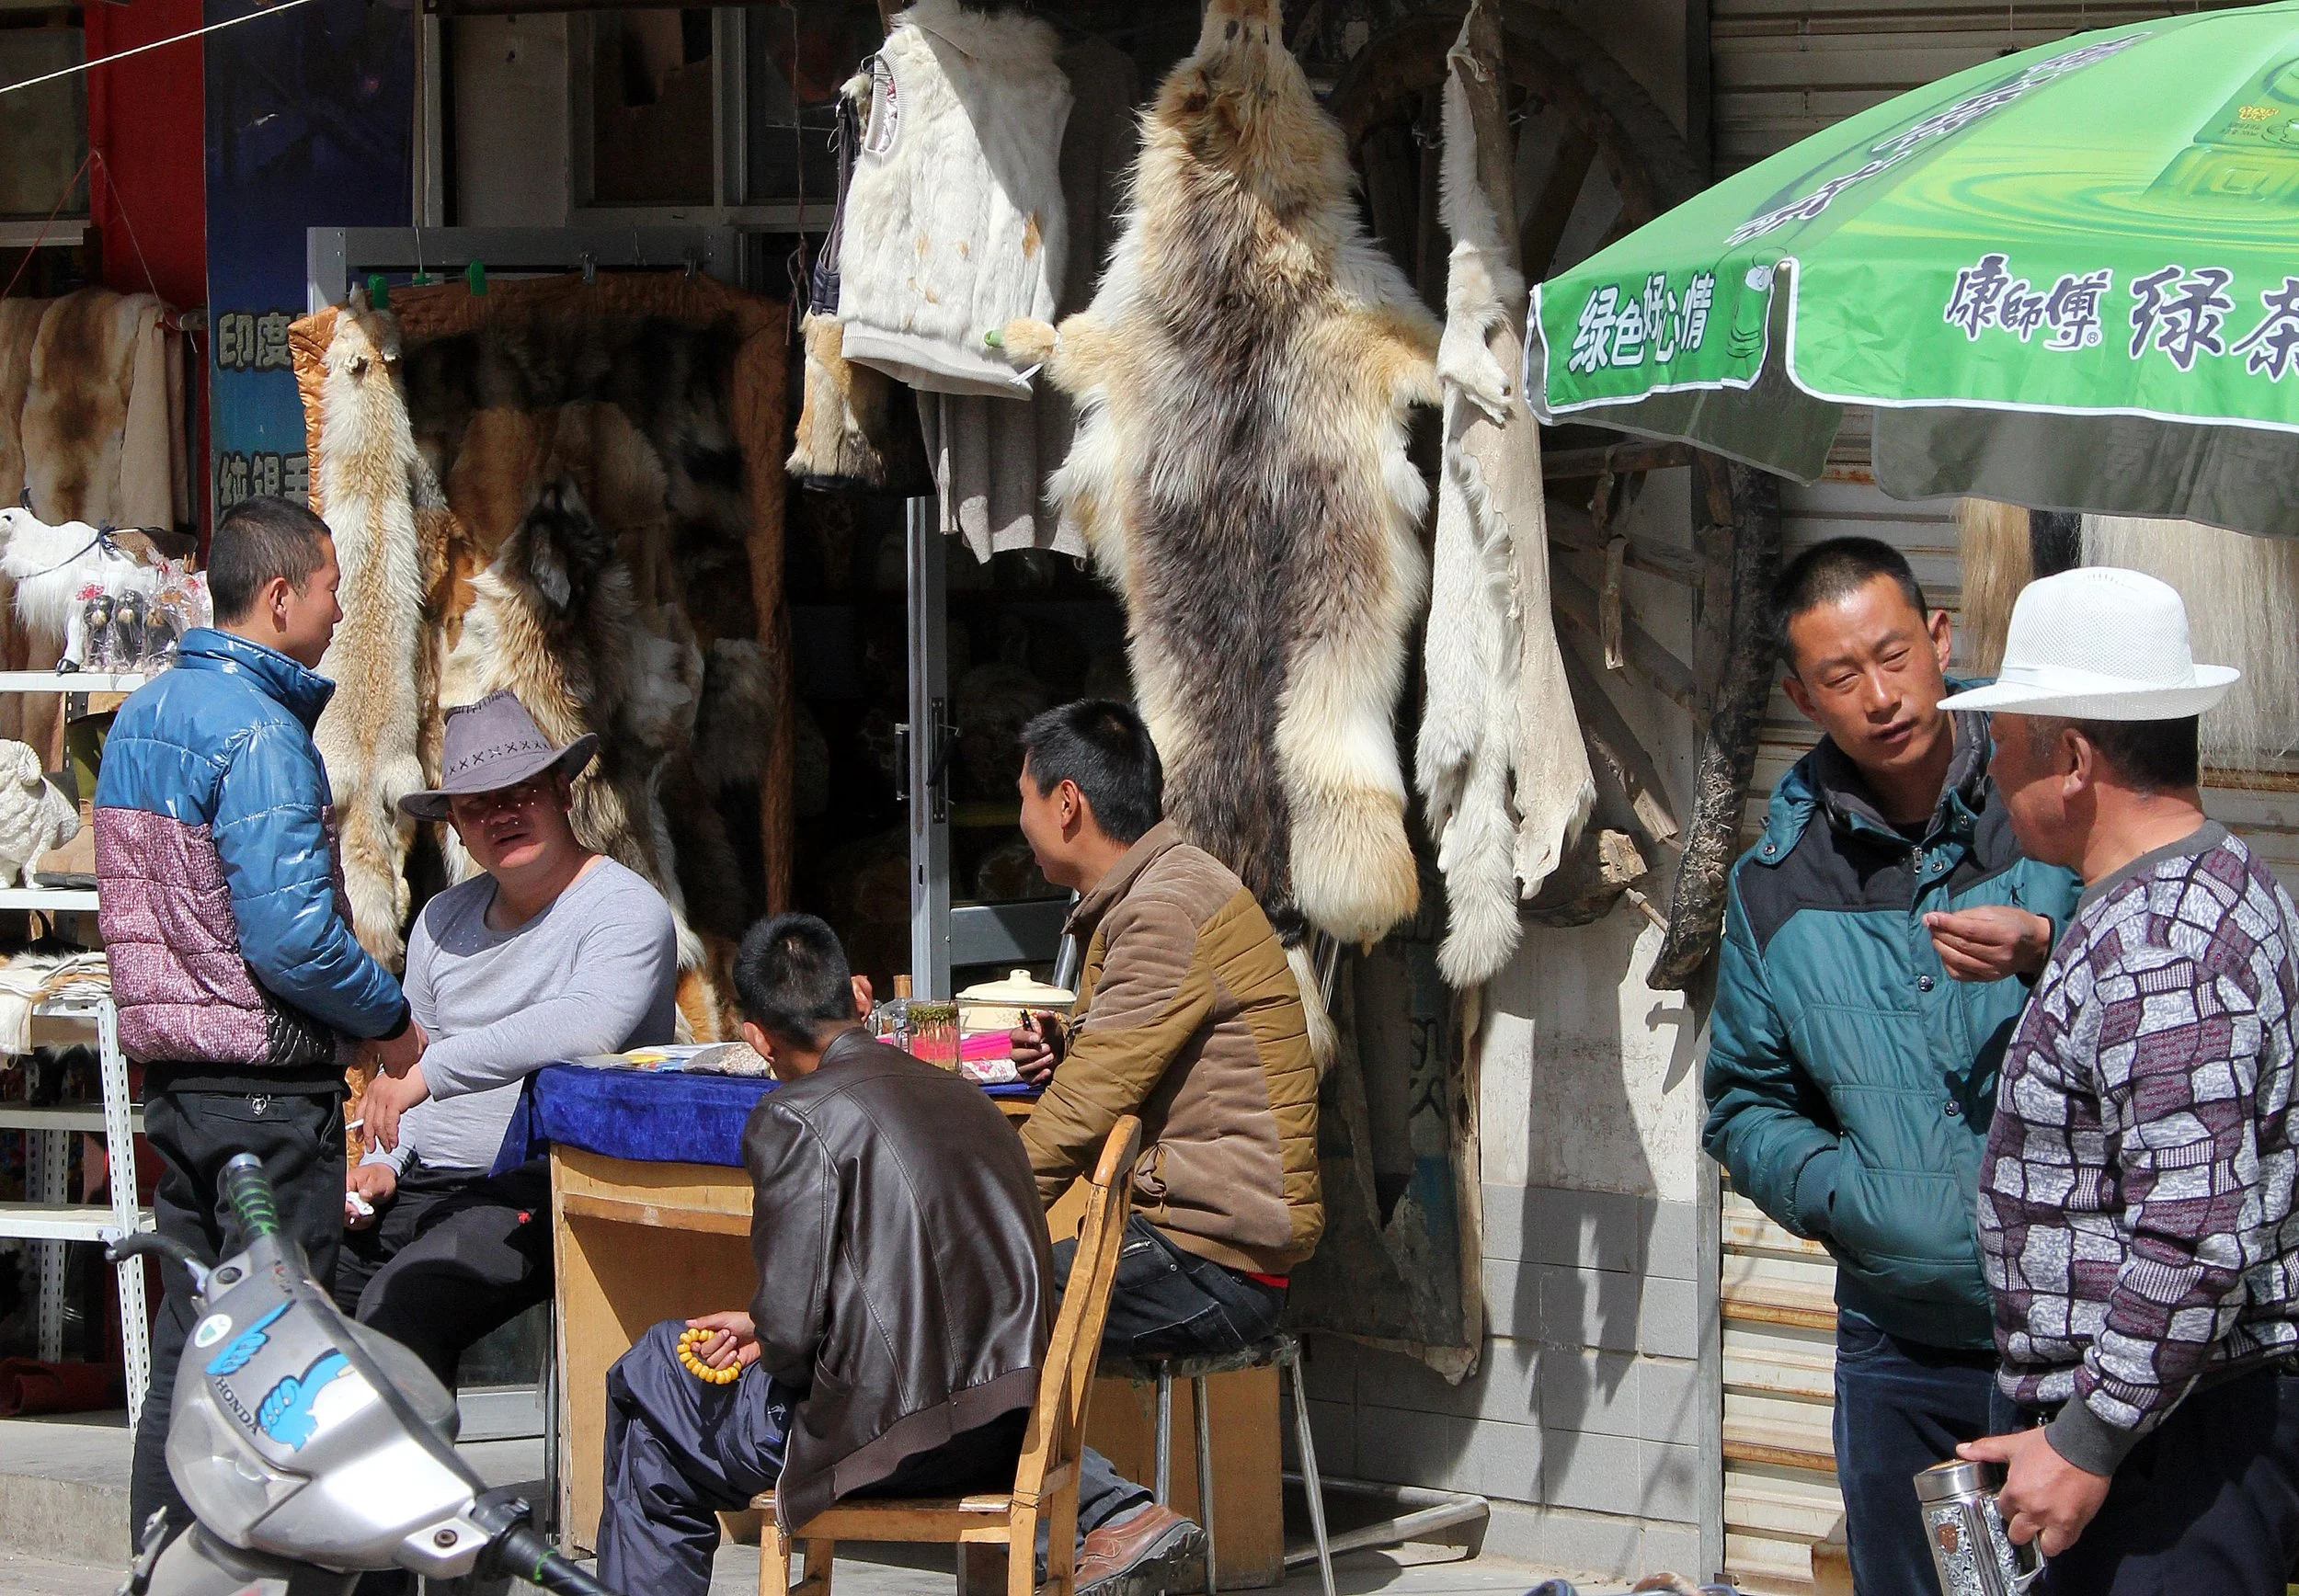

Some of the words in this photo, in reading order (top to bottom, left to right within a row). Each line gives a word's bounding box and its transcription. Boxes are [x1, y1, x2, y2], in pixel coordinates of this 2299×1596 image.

[219, 312, 307, 370] 印度
[1568, 272, 1714, 373] 绿色好心情
[214, 1377, 260, 1436] HONDA
